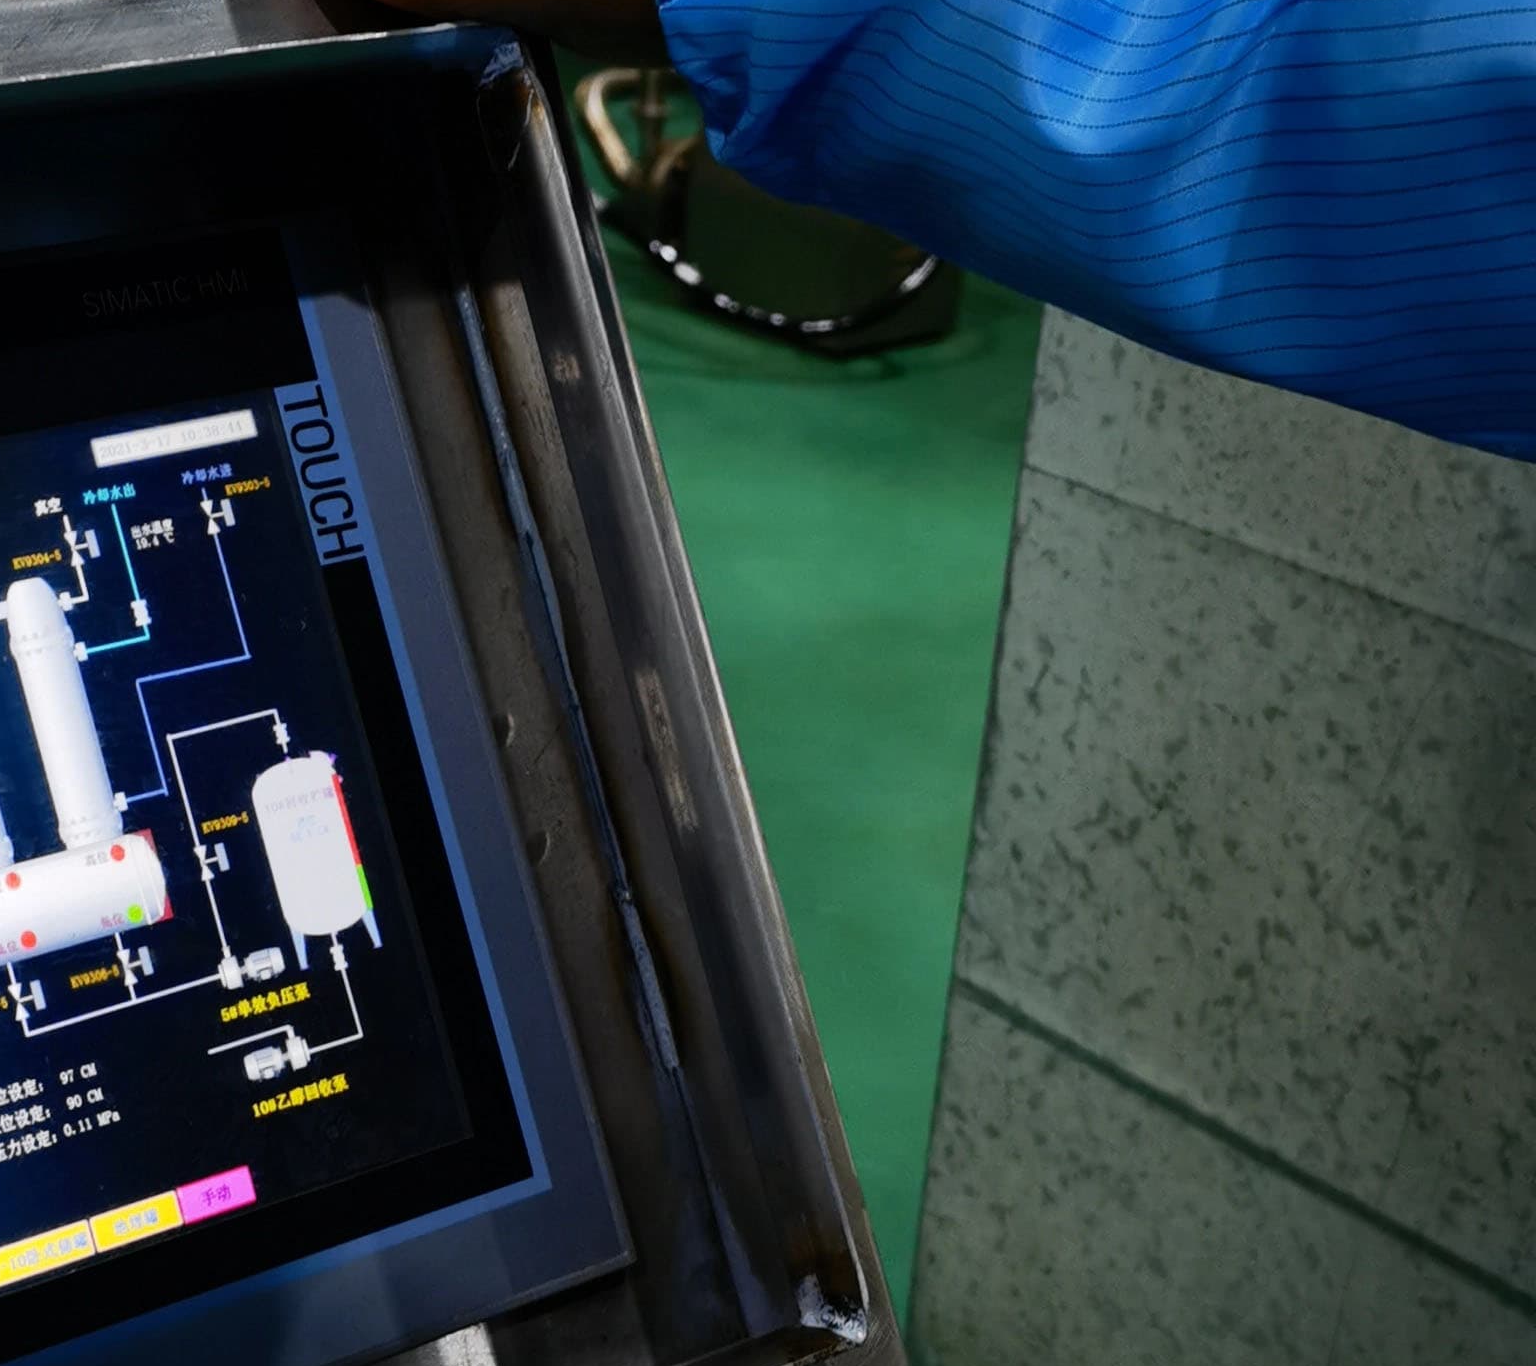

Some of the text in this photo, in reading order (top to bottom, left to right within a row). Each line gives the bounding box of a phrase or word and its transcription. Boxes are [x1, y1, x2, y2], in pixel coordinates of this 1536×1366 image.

[81, 276, 191, 319] SIMATIC
[283, 385, 365, 560] TOUCH
[82, 483, 136, 505] 冷却水出
[220, 982, 311, 1023] 5#单效负压泵
[59, 1068, 75, 1085] 97
[66, 1094, 82, 1110] 90
[251, 1073, 350, 1119] 10#乙醇回收泵
[63, 1118, 93, 1137] 0.11
[200, 1183, 232, 1207] 手动
